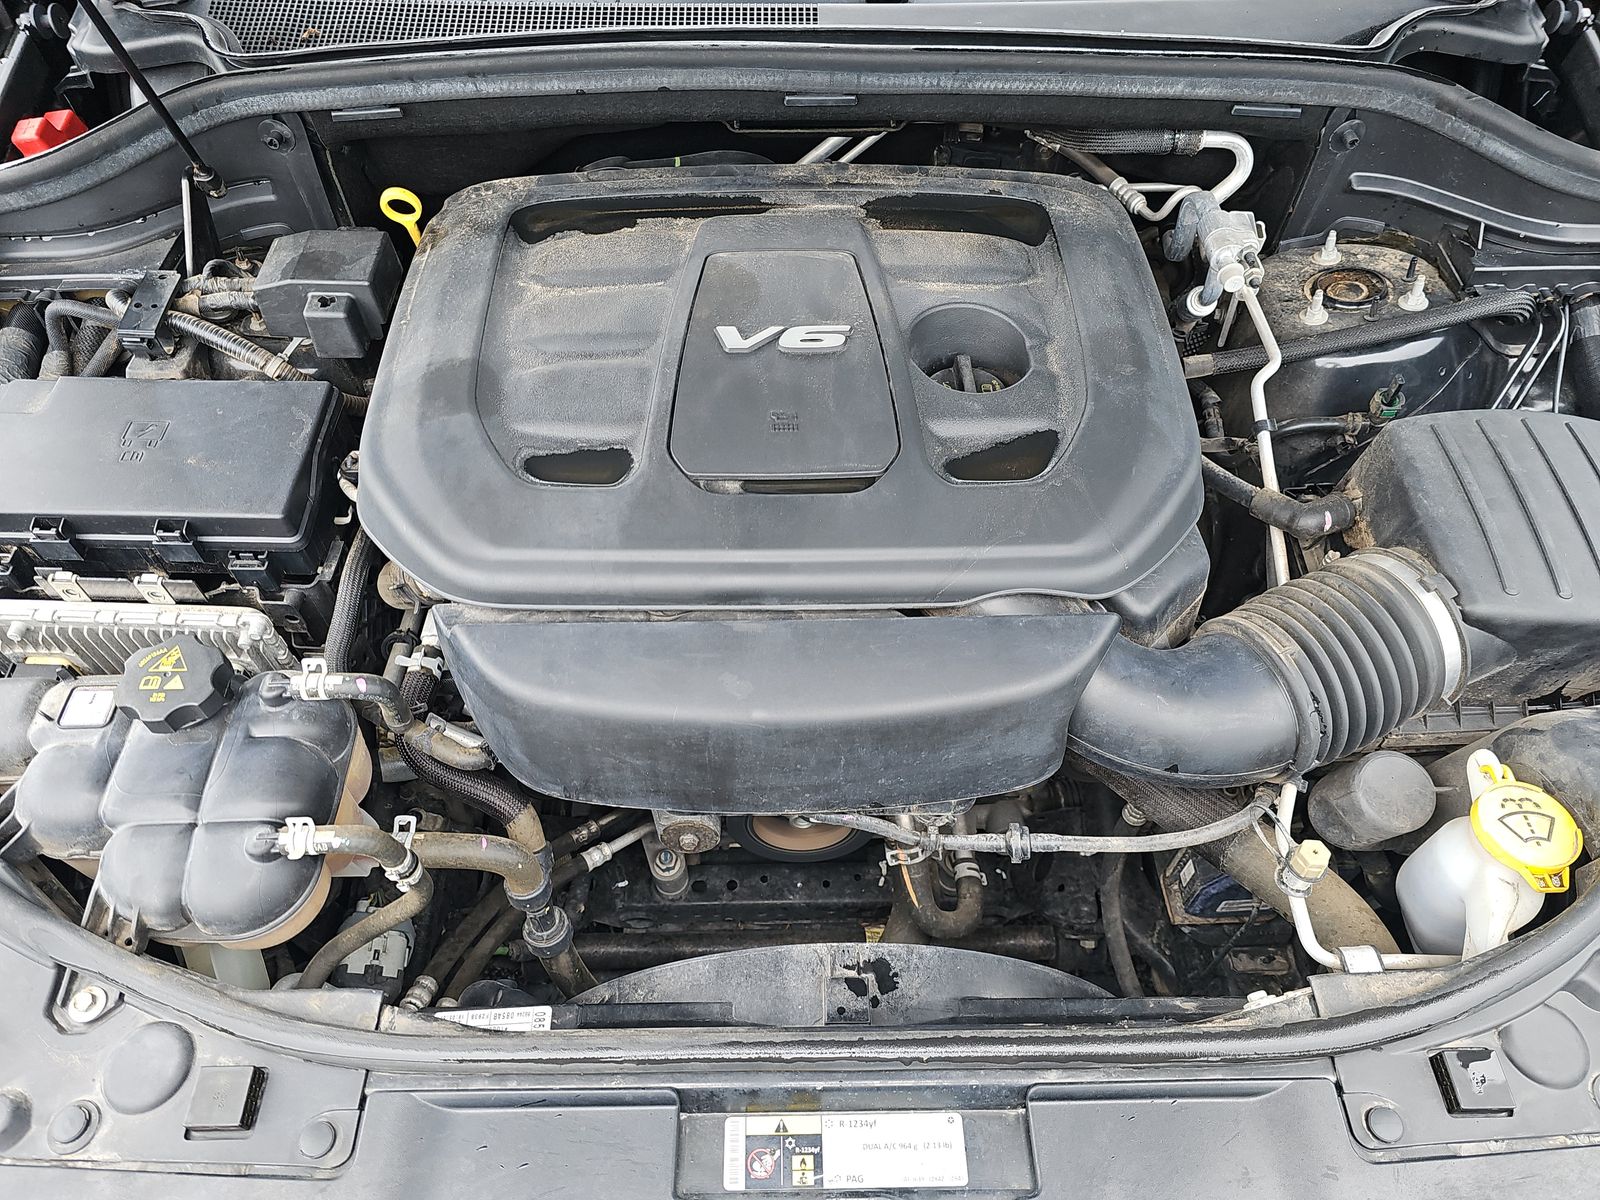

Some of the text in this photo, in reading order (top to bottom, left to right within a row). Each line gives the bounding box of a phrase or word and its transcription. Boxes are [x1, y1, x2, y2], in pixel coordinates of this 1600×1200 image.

[714, 325, 853, 353] V6
[533, 1011, 546, 1029] 085
[838, 1119, 877, 1130] R-1234yf
[794, 1146, 821, 1155] R-1234yf
[862, 1143, 882, 1151] DUAL
[883, 1143, 897, 1151] A/C
[898, 1142, 912, 1150] 964
[846, 1175, 865, 1184] PAG
